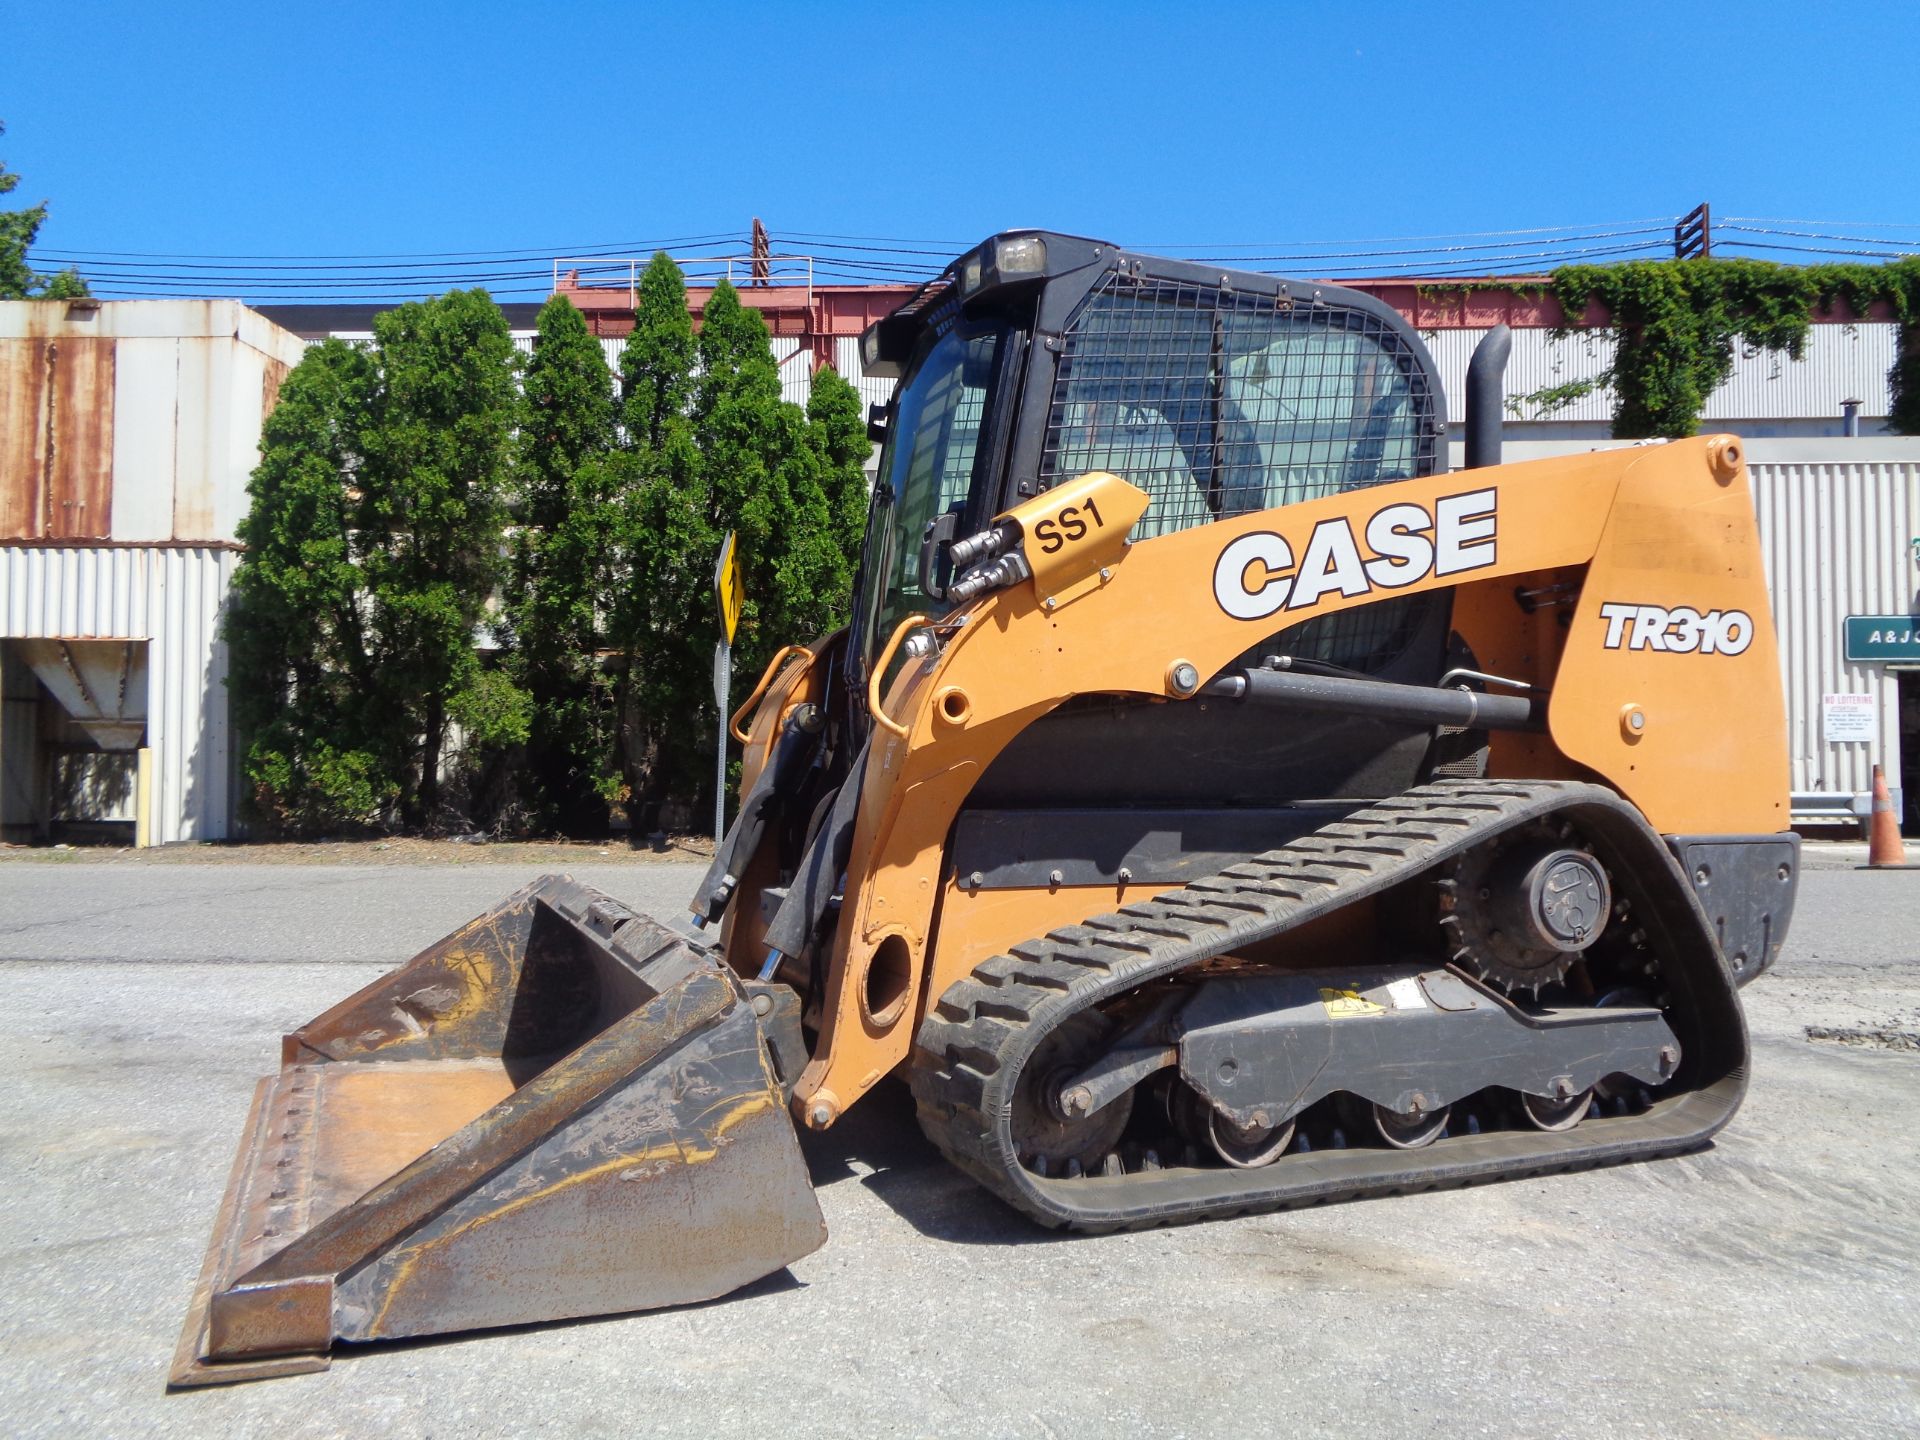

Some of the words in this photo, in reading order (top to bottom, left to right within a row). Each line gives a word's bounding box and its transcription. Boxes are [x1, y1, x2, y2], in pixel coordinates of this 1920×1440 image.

[1034, 496, 1104, 554] SS1
[1212, 486, 1498, 621] CASE
[1599, 602, 1754, 657] TR310
